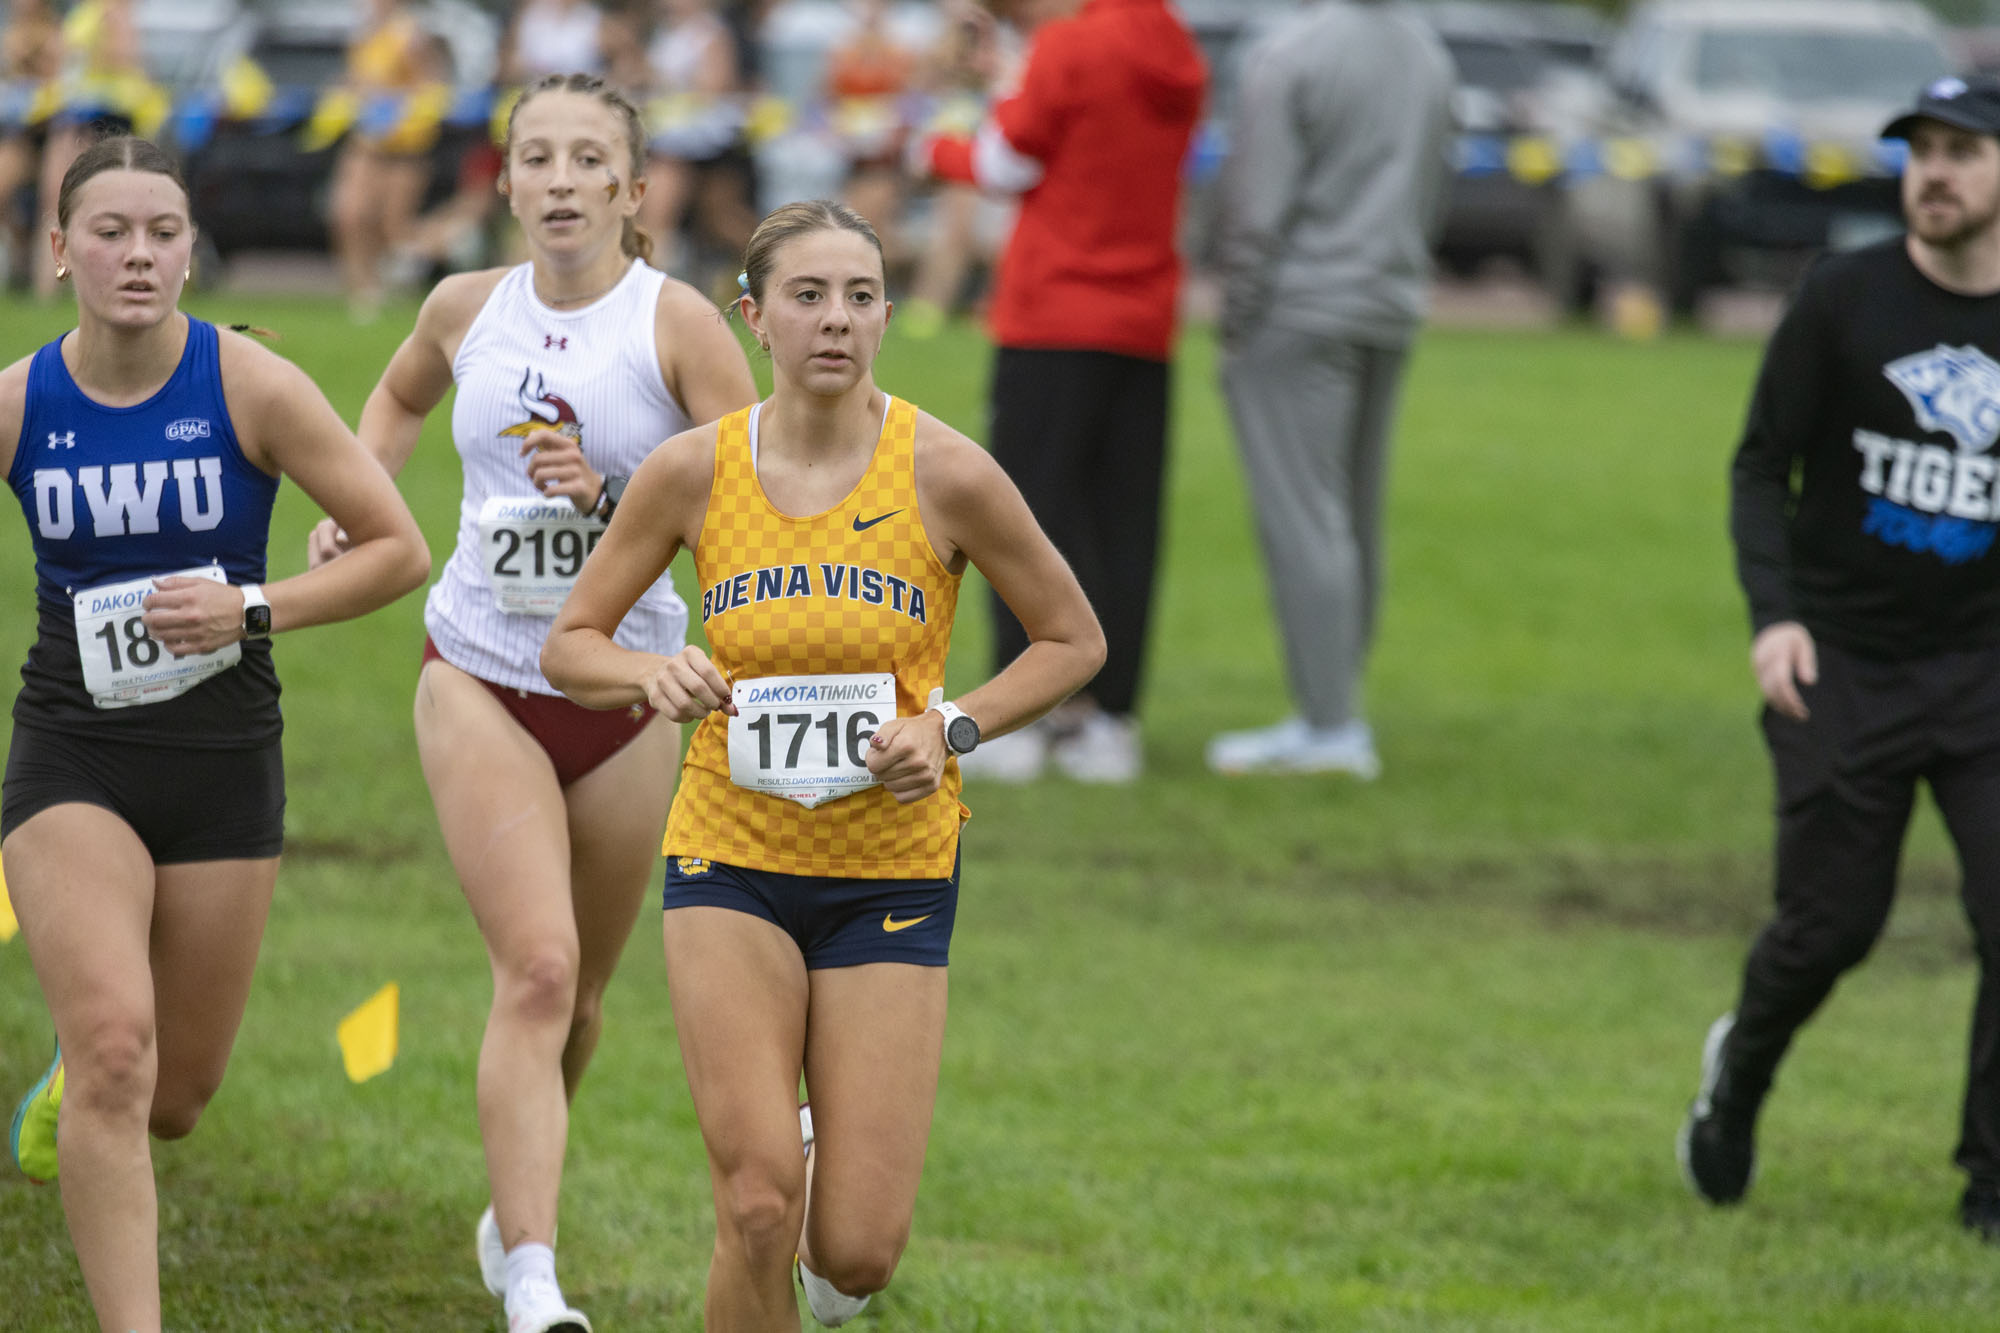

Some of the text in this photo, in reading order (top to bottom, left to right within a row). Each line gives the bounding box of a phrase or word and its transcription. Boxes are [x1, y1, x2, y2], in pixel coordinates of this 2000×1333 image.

[168, 422, 208, 438] GPAC
[33, 456, 224, 540] DWU
[1852, 428, 2000, 522] TIGE
[498, 504, 582, 520] DAKOTATI
[703, 563, 927, 625] BUENA VISTA
[95, 615, 184, 672] 18
[747, 710, 880, 770] 1716
[757, 774, 870, 786] RESULTS.DAKOTATIMING.COM
